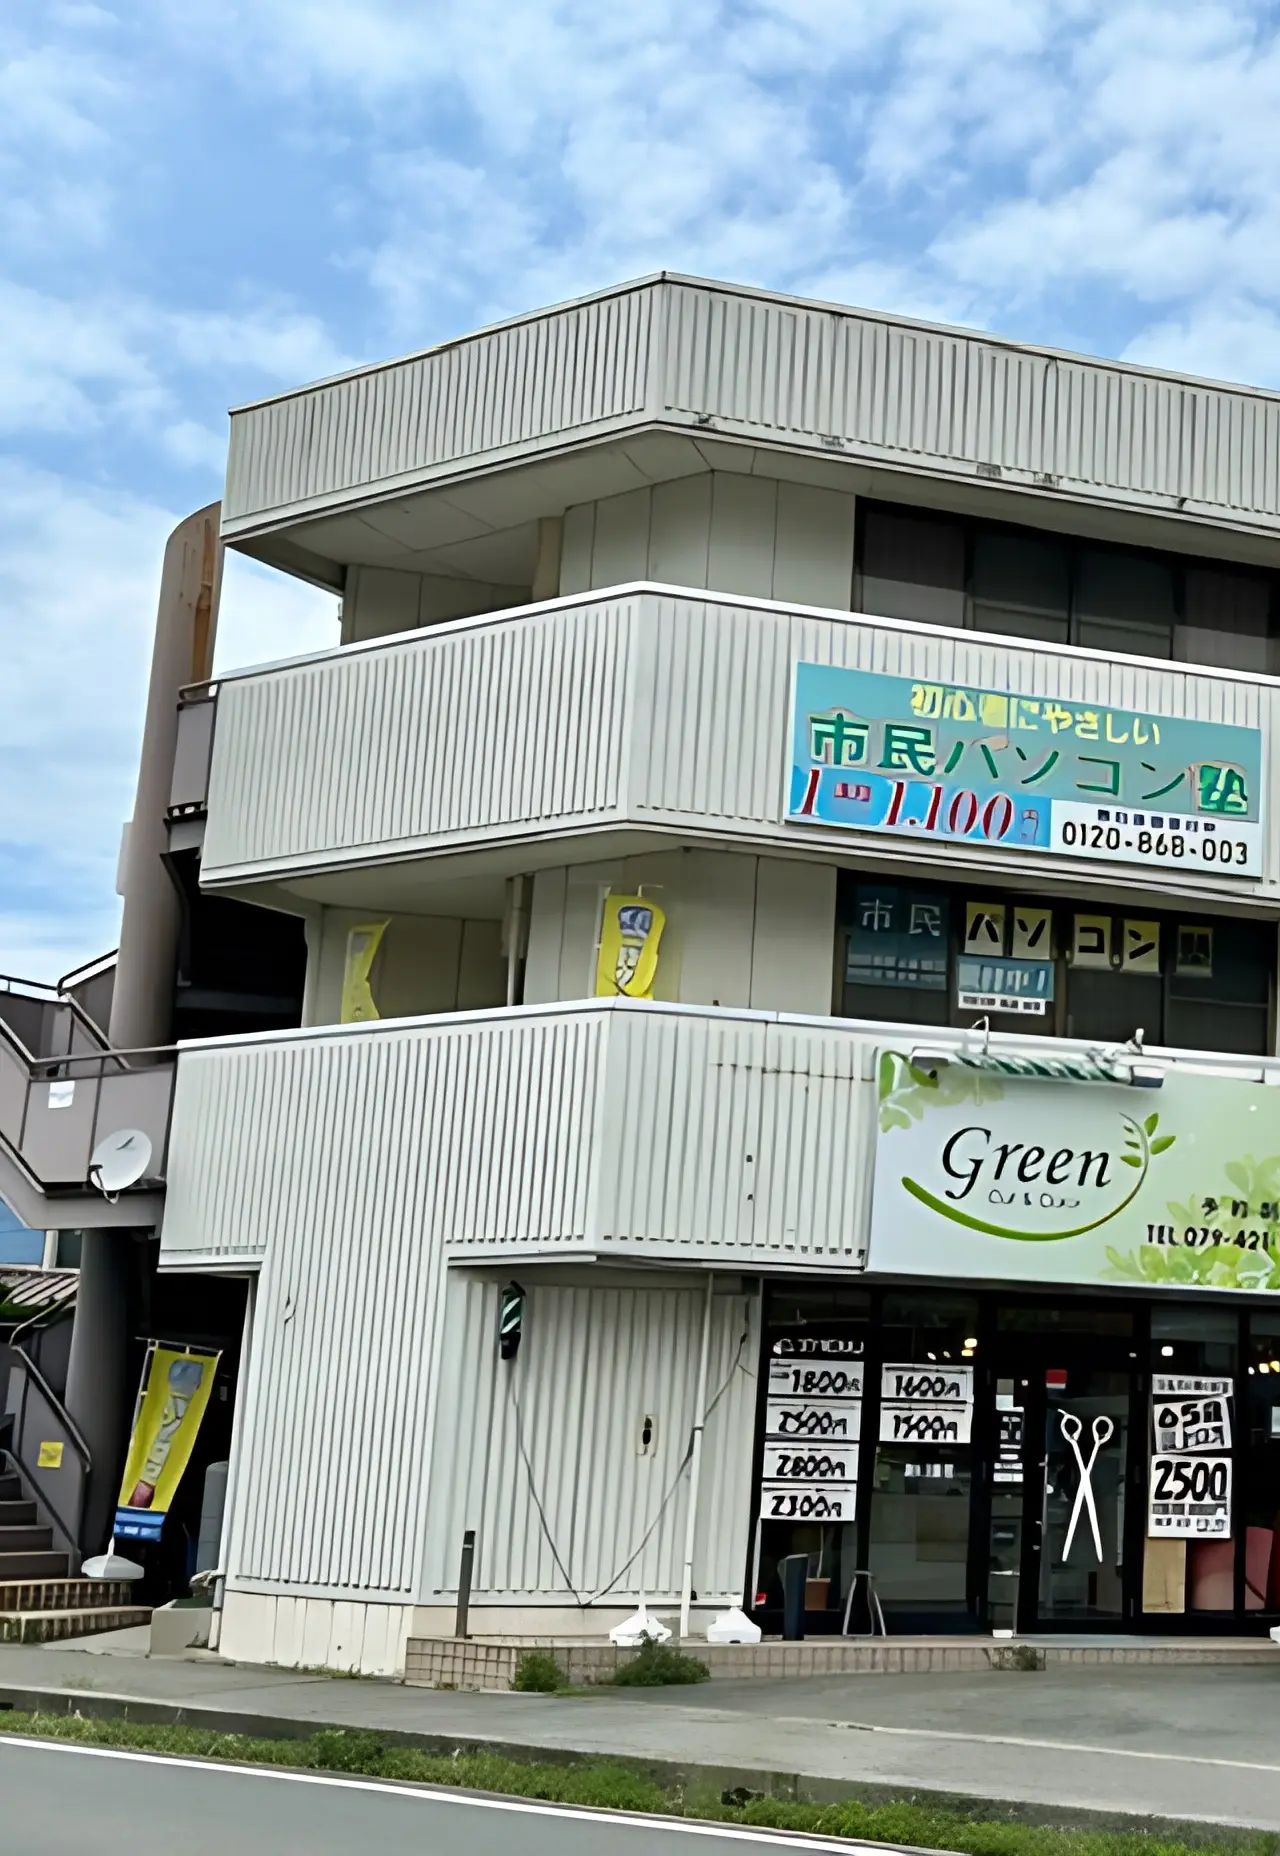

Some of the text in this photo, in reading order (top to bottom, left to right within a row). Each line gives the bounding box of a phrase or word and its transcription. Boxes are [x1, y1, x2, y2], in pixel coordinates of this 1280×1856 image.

[911, 684, 1160, 745] 初心にやさしい
[941, 1126, 1112, 1200] Green
